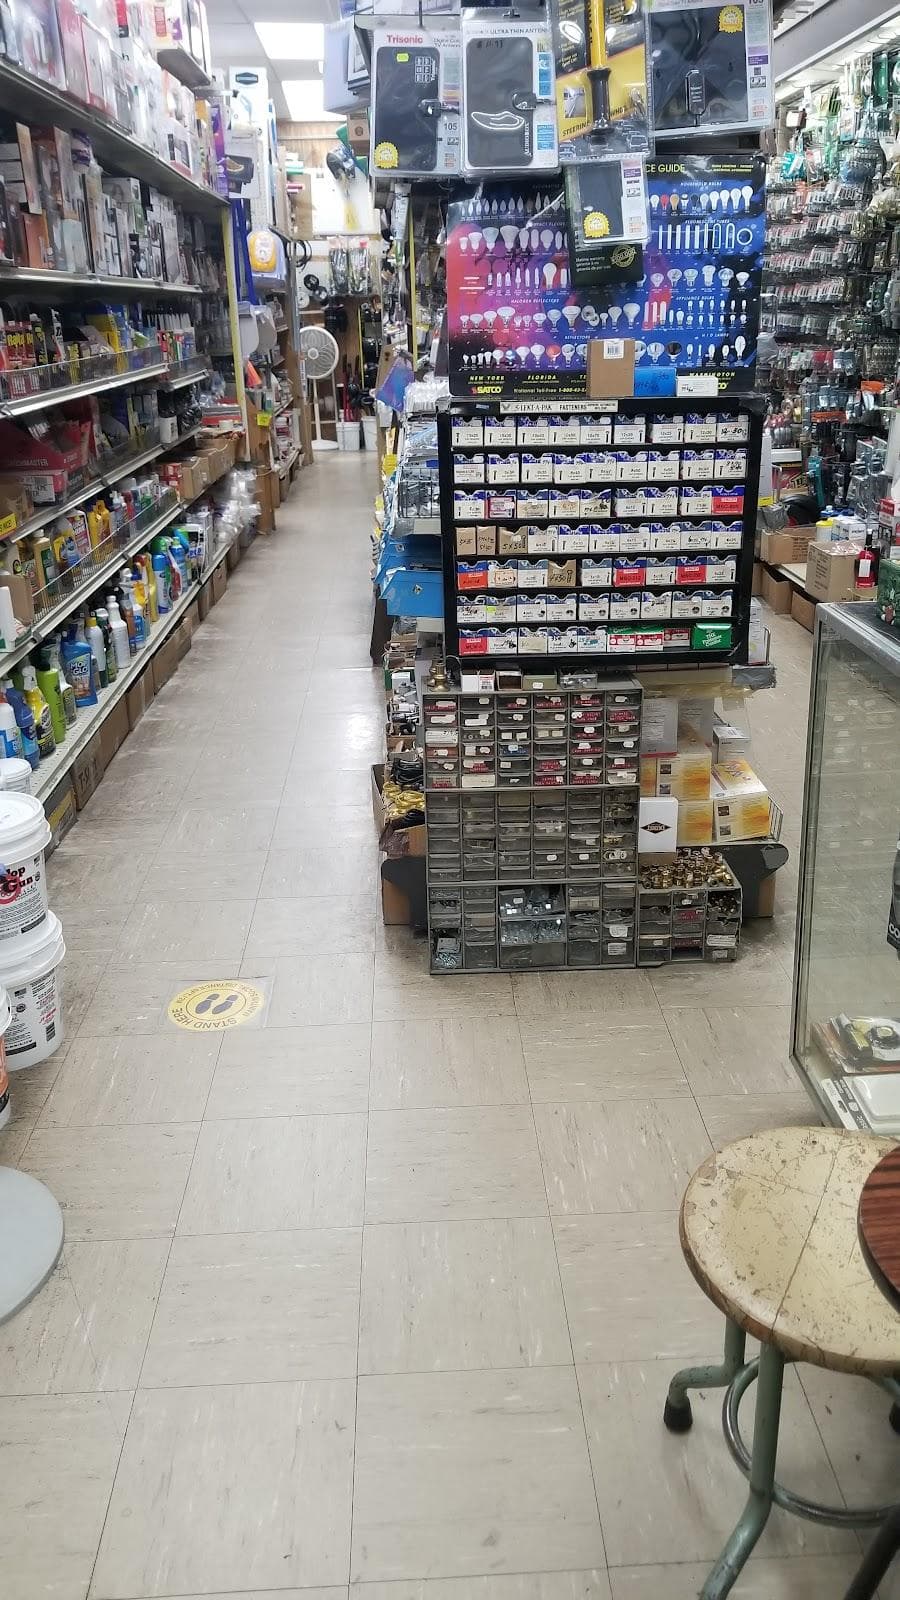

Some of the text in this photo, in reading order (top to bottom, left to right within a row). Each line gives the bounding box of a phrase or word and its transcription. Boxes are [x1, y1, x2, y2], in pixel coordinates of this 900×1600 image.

[386, 34, 424, 44] Trisonic
[444, 122, 458, 130] 105
[658, 164, 686, 173] GUIDE
[477, 386, 502, 394] SATCO
[172, 1007, 238, 1029] STAND HERE
